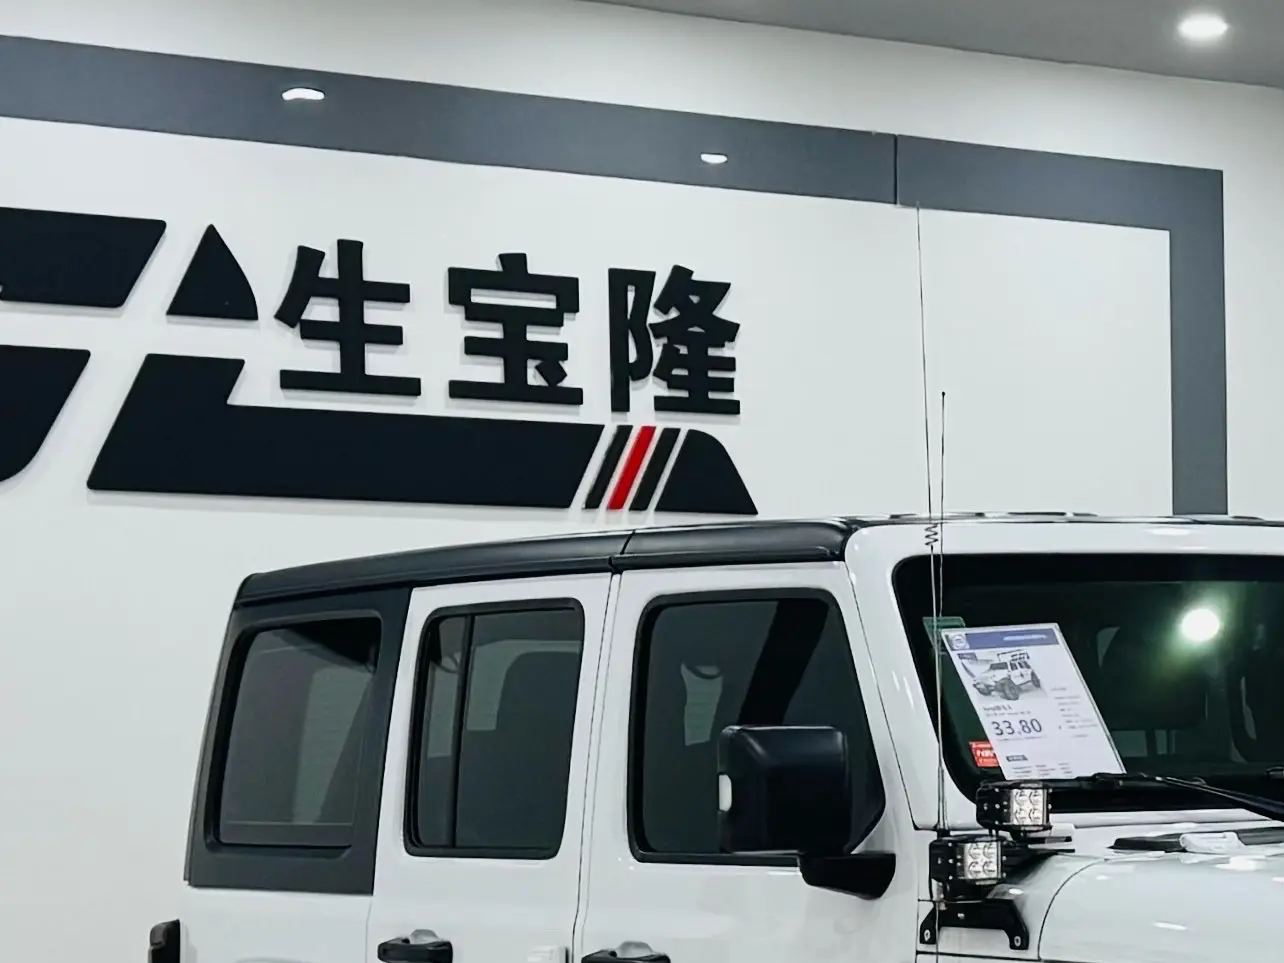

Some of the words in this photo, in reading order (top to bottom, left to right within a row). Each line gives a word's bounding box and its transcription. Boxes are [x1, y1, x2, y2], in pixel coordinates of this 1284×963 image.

[274, 239, 740, 415] 生宝隆
[991, 718, 1043, 736] 33.80
